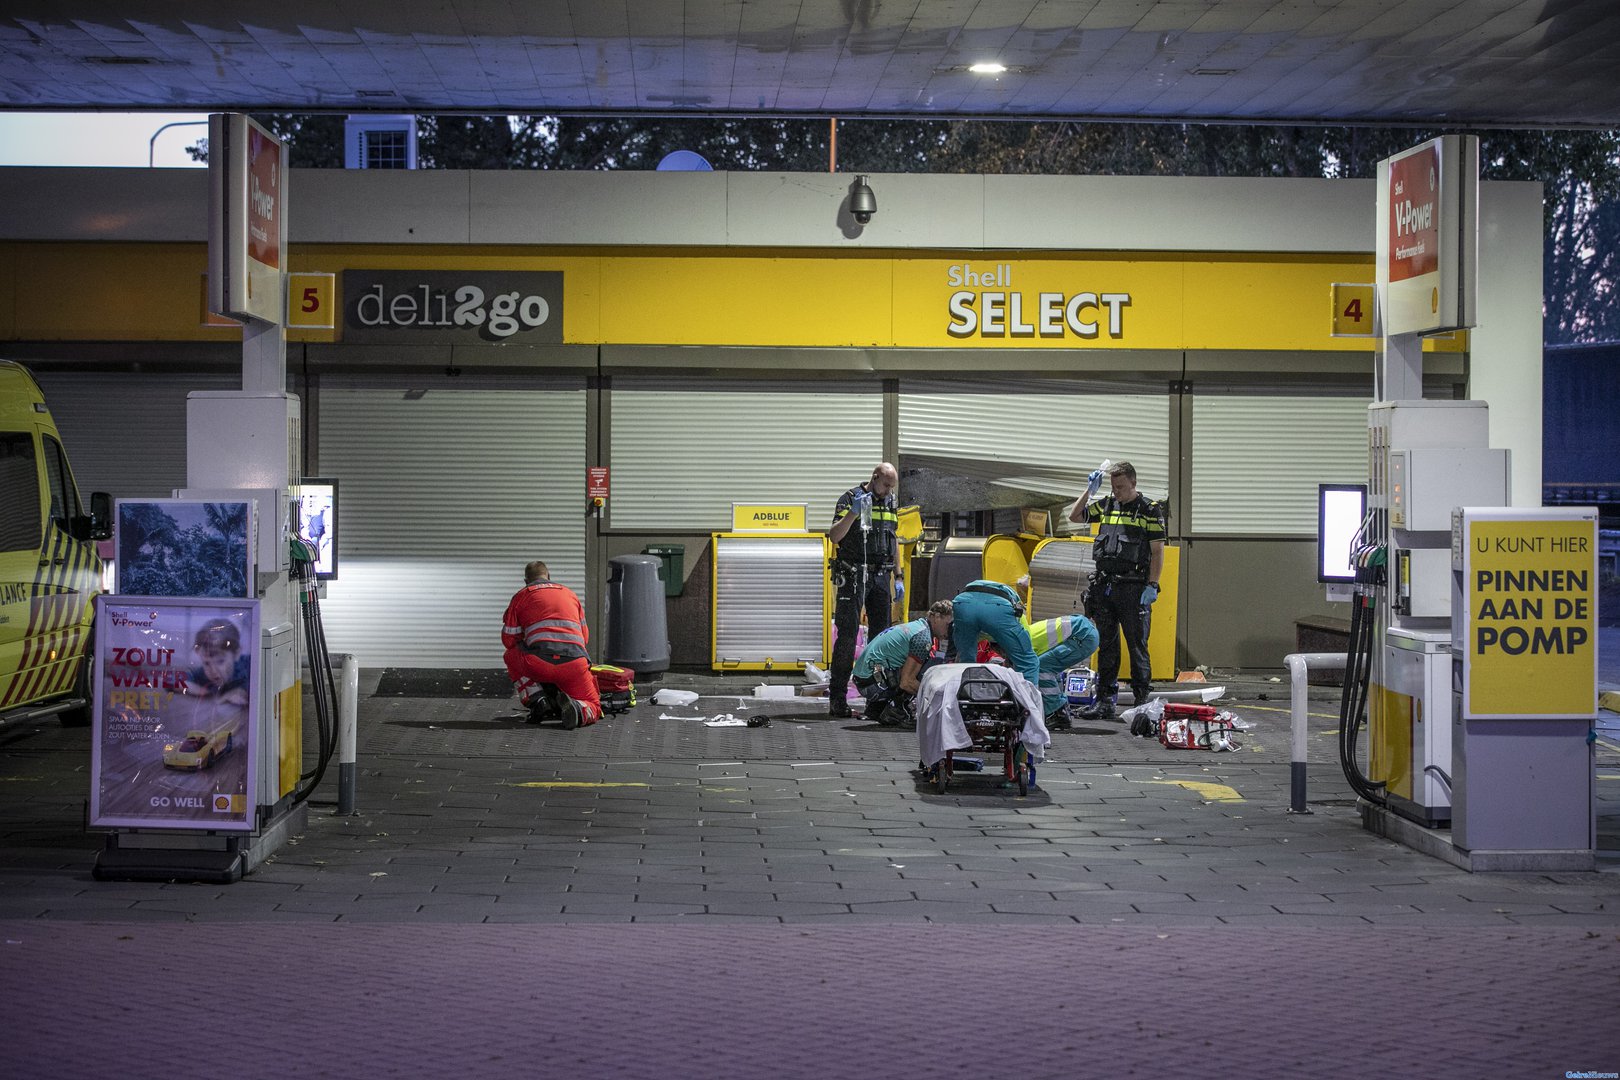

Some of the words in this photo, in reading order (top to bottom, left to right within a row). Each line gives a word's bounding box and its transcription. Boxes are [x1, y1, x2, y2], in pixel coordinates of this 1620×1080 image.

[1395, 200, 1434, 238] V-Power
[947, 264, 1011, 287] Shell
[301, 287, 320, 313] 5
[357, 284, 550, 337] deli2go
[1343, 298, 1363, 323] 4
[947, 291, 1132, 339] SELECT
[752, 512, 790, 521] ADBLUE
[1477, 537, 1490, 553] U
[1496, 537, 1545, 553] KUNT
[1551, 537, 1588, 553] HIER
[1477, 570, 1588, 592] PINNEN
[1478, 598, 1543, 620] AAN
[1555, 598, 1588, 620] DE
[111, 618, 154, 627] V-Power
[1477, 626, 1588, 656] POMP
[111, 647, 176, 667] ZOUT
[111, 670, 189, 689] WATER
[150, 796, 171, 808] GO
[174, 797, 206, 808] WELL
